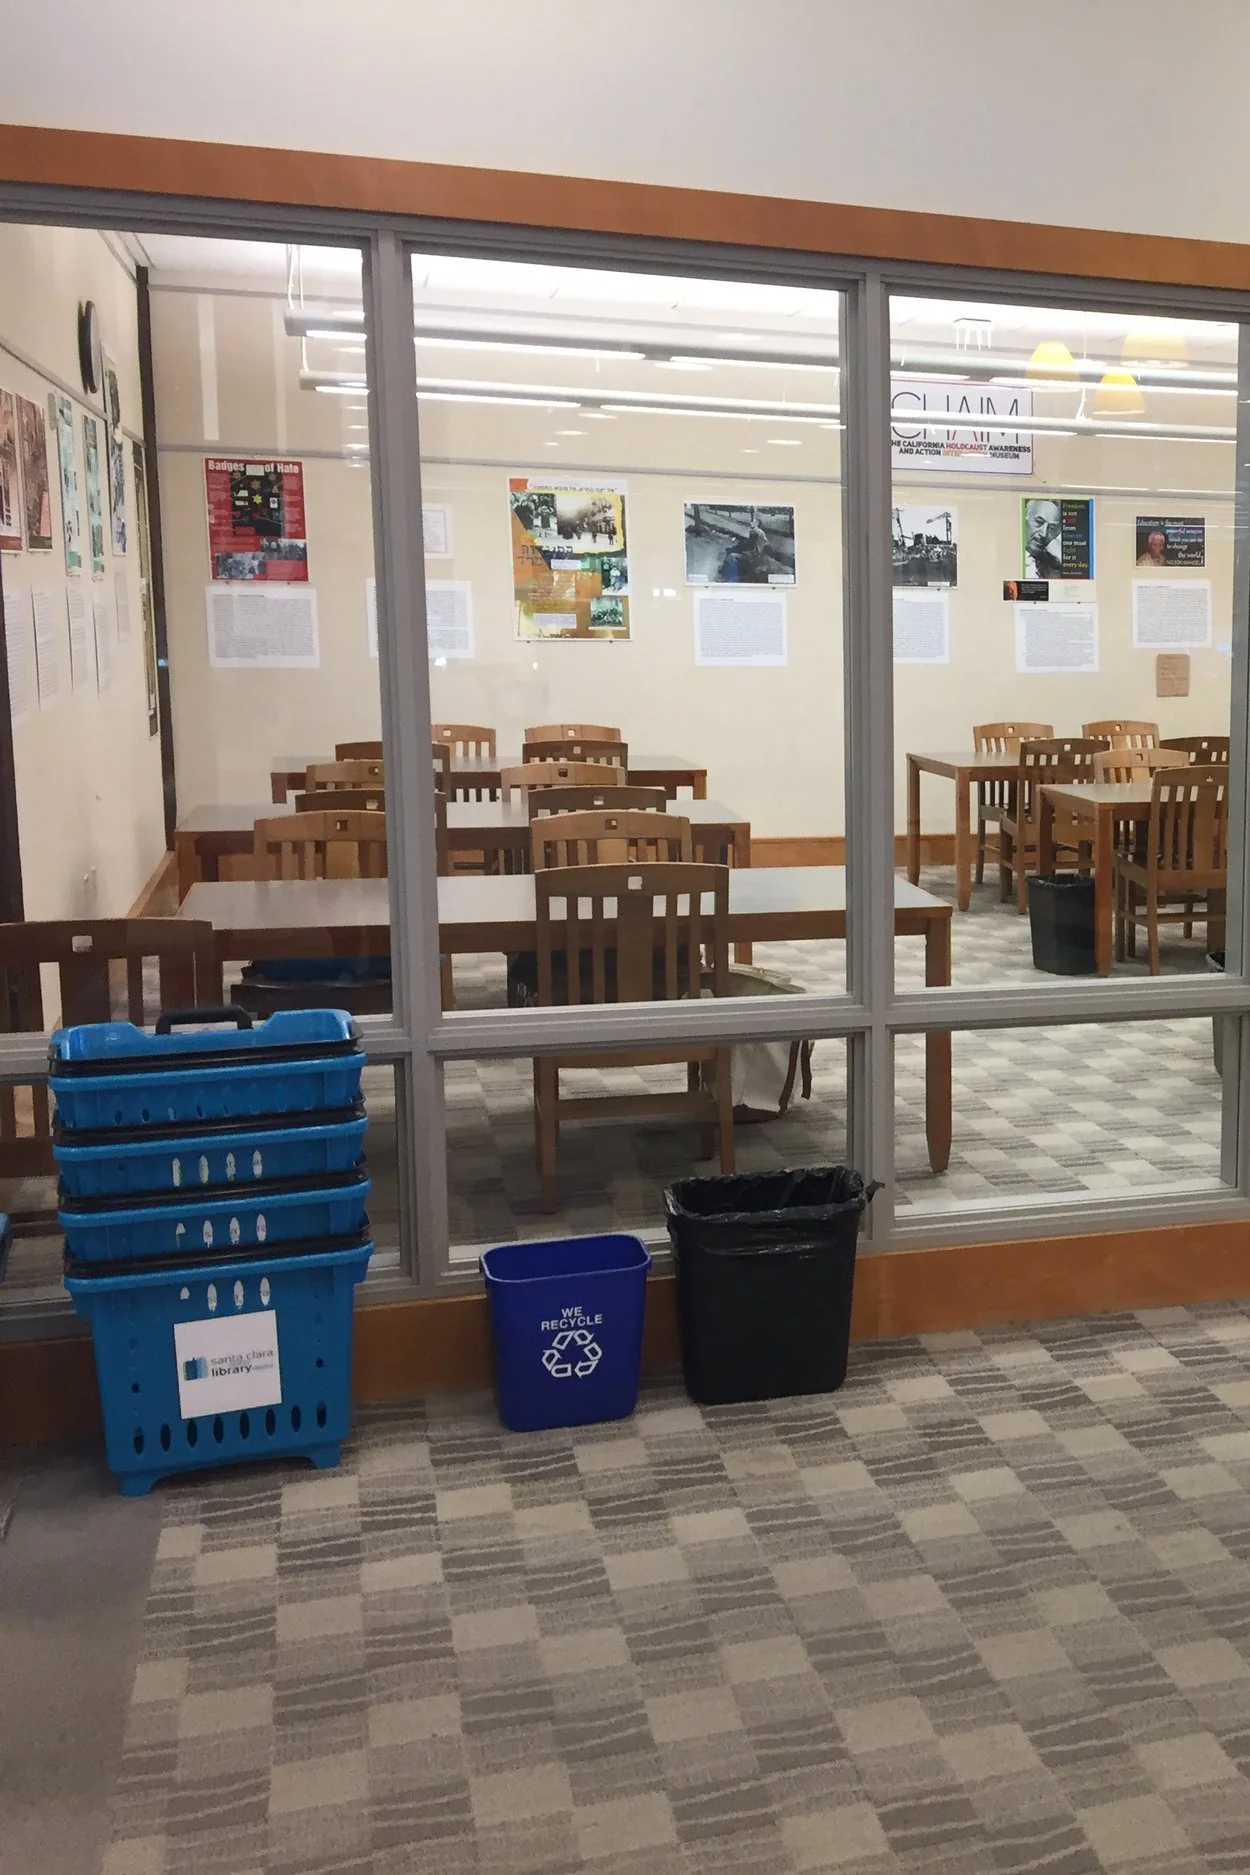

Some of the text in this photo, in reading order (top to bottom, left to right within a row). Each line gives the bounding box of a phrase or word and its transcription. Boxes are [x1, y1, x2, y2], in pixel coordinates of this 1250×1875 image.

[891, 391, 1019, 444] CHAIM
[899, 447, 914, 455] AND
[915, 448, 941, 456] ACTION
[902, 440, 945, 449] CALIFORNIA
[945, 442, 987, 451] HOLOCAUST
[988, 444, 1031, 453] AWARENESS
[207, 460, 300, 473] Badges of Hate
[561, 1305, 583, 1318] WE
[541, 1313, 603, 1332] RECYCLE
[210, 1353, 243, 1366] santa
[246, 1349, 274, 1360] clara
[211, 1364, 252, 1377] library
